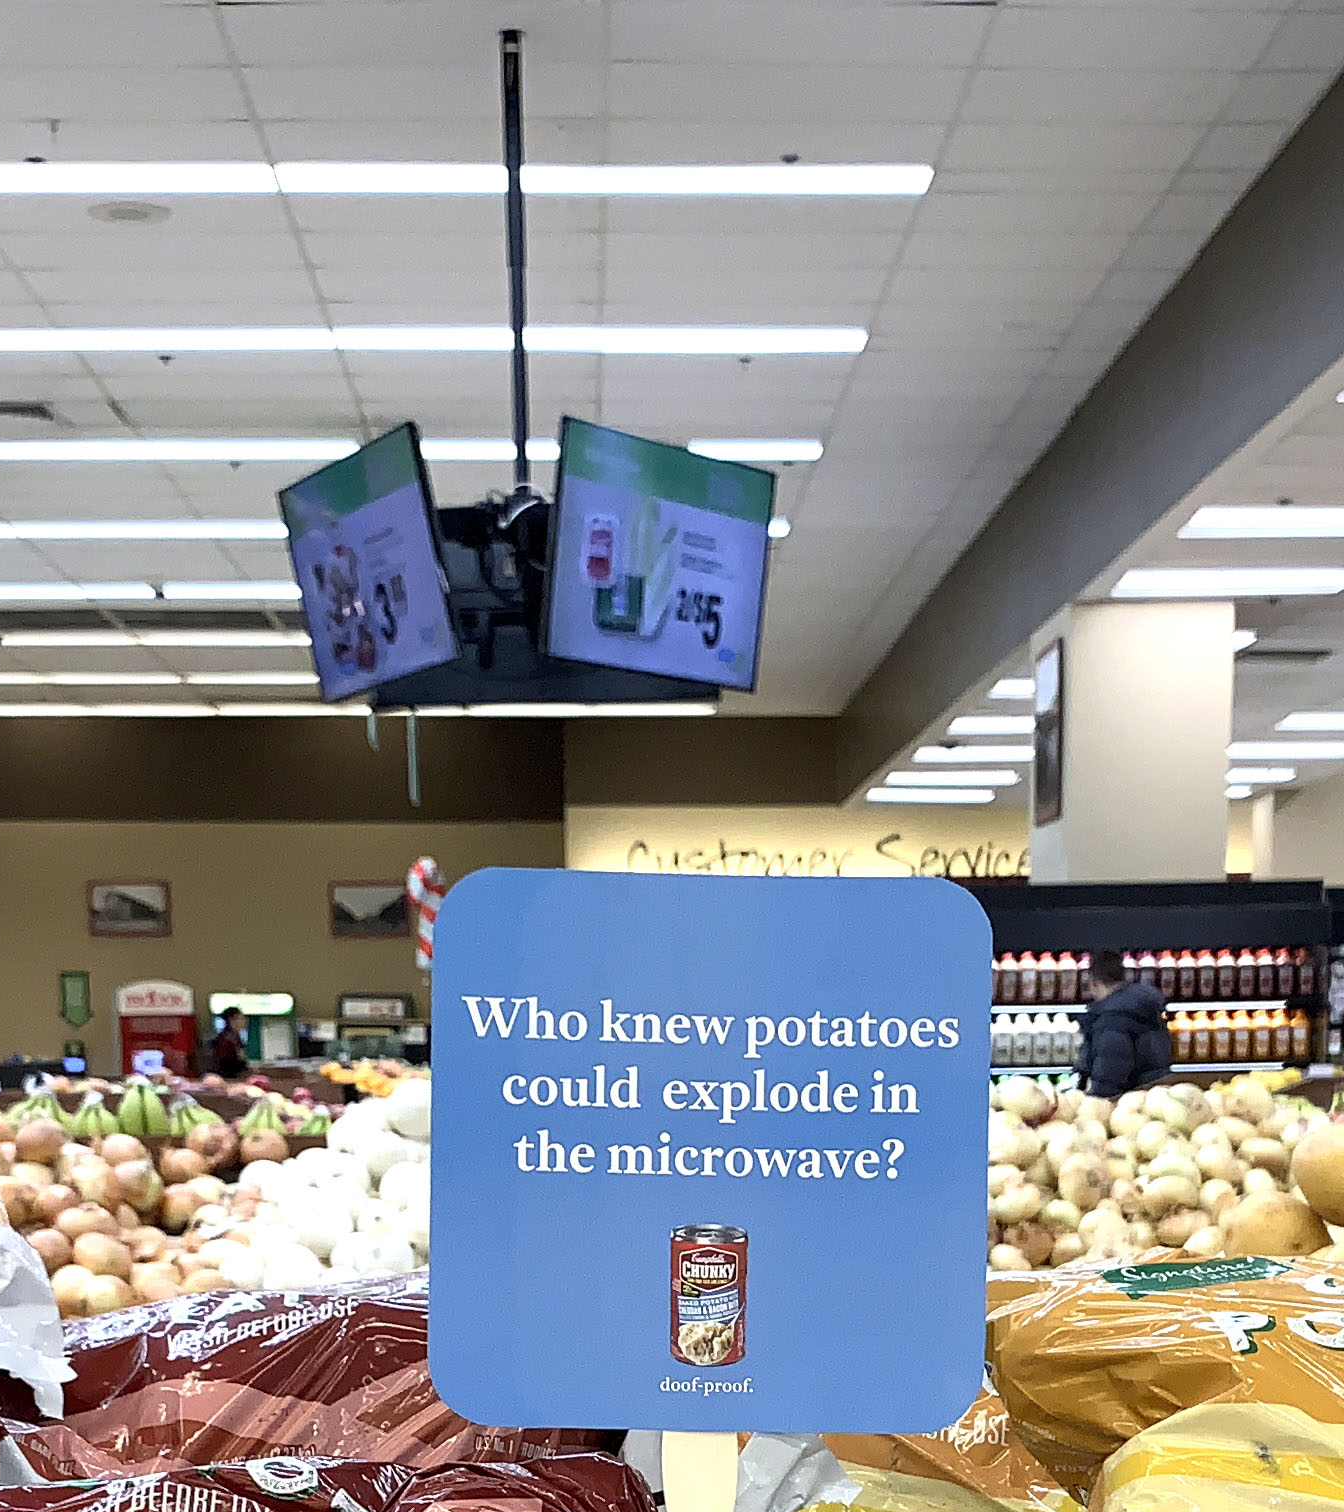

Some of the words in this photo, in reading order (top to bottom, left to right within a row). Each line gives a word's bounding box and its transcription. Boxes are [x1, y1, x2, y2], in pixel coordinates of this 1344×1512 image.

[876, 833, 1031, 878] Service
[462, 995, 588, 1041] Who
[599, 998, 735, 1045] knew
[745, 1008, 960, 1058] potatoes
[502, 1065, 642, 1109] could
[662, 1069, 859, 1125] explode
[869, 1070, 920, 1114] in
[513, 1130, 595, 1174] the
[607, 1132, 905, 1180] microwave?
[682, 1262, 736, 1281] CHUNKY
[319, 1296, 360, 1320] USE
[659, 1377, 755, 1397] doof-proof.
